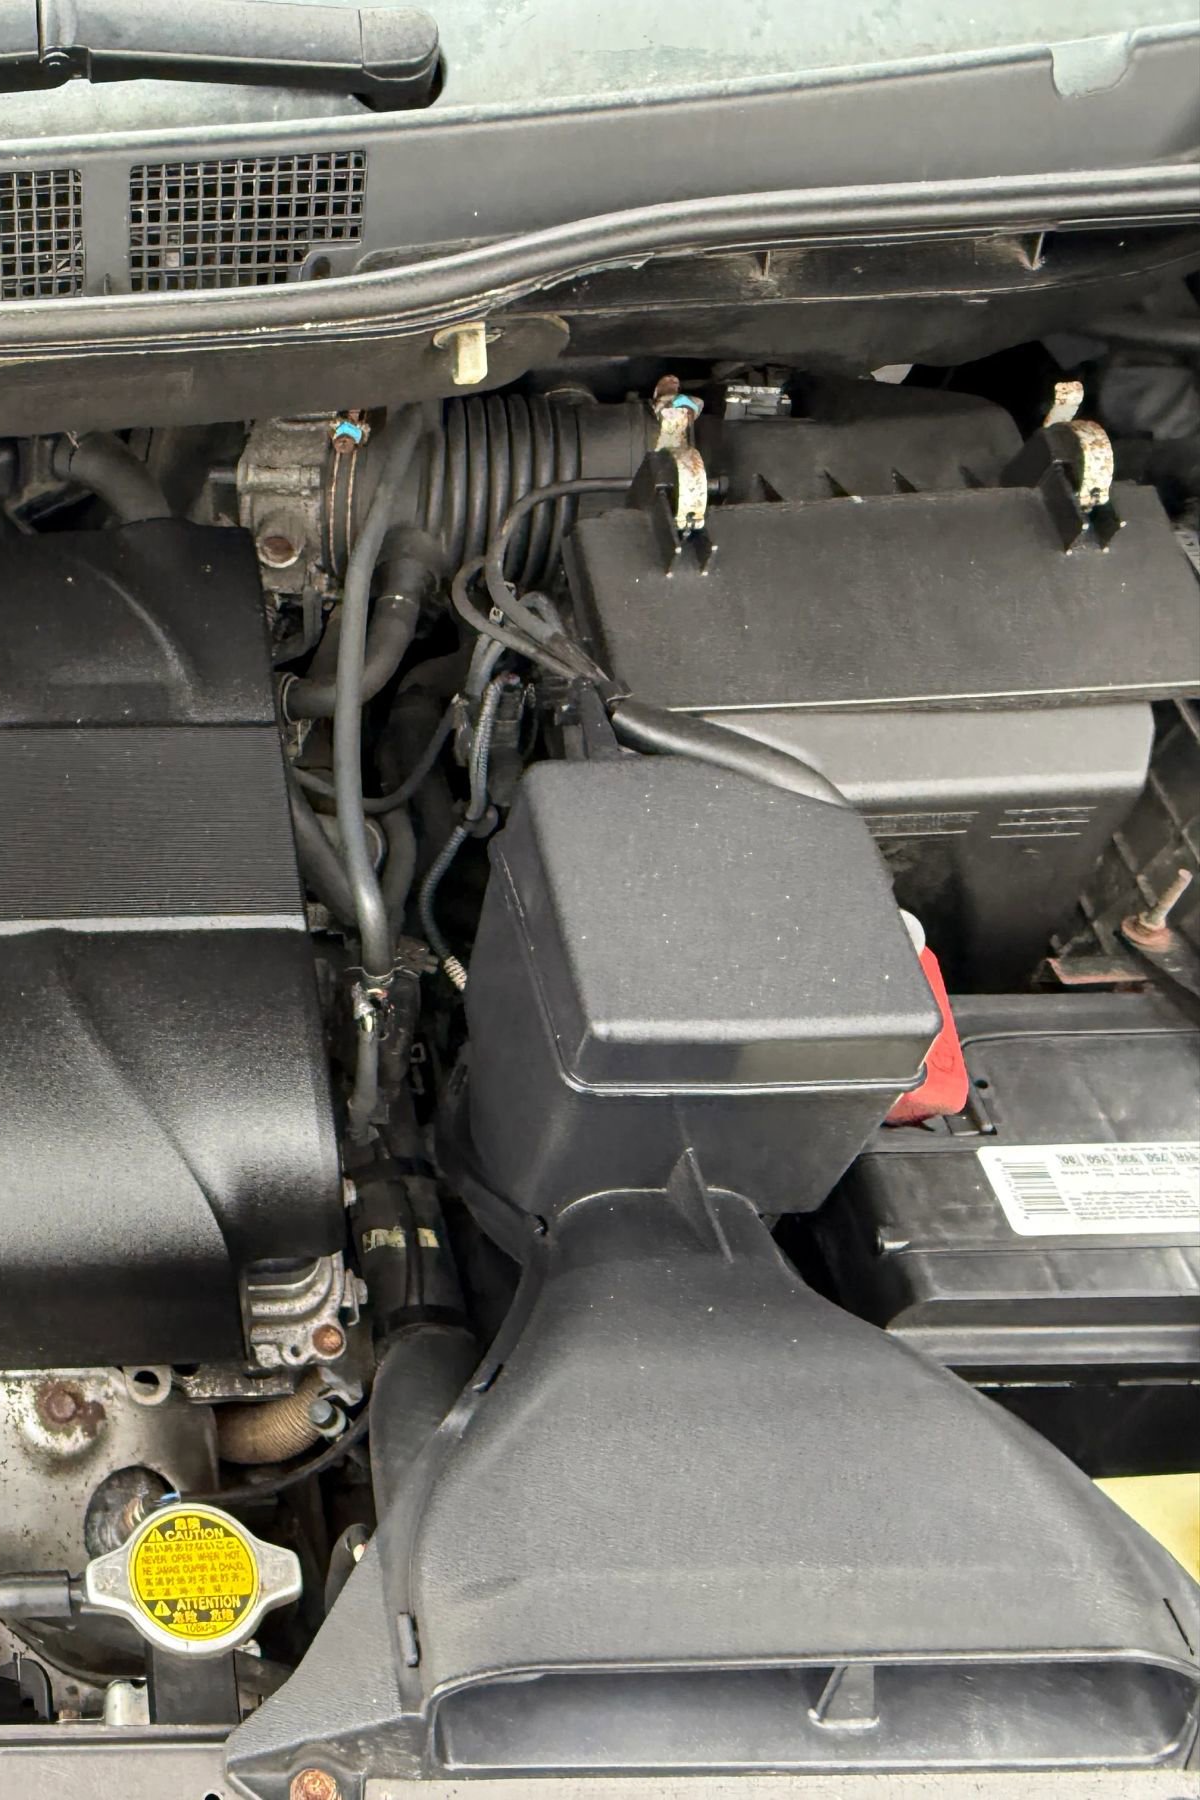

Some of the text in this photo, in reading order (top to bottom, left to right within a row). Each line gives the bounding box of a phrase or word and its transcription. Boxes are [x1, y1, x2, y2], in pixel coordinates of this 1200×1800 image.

[164, 1528, 225, 1541] CAUTION
[171, 1553, 193, 1563] OPEN
[198, 1551, 220, 1561] WHEN
[176, 1595, 241, 1611] ATTENTION
